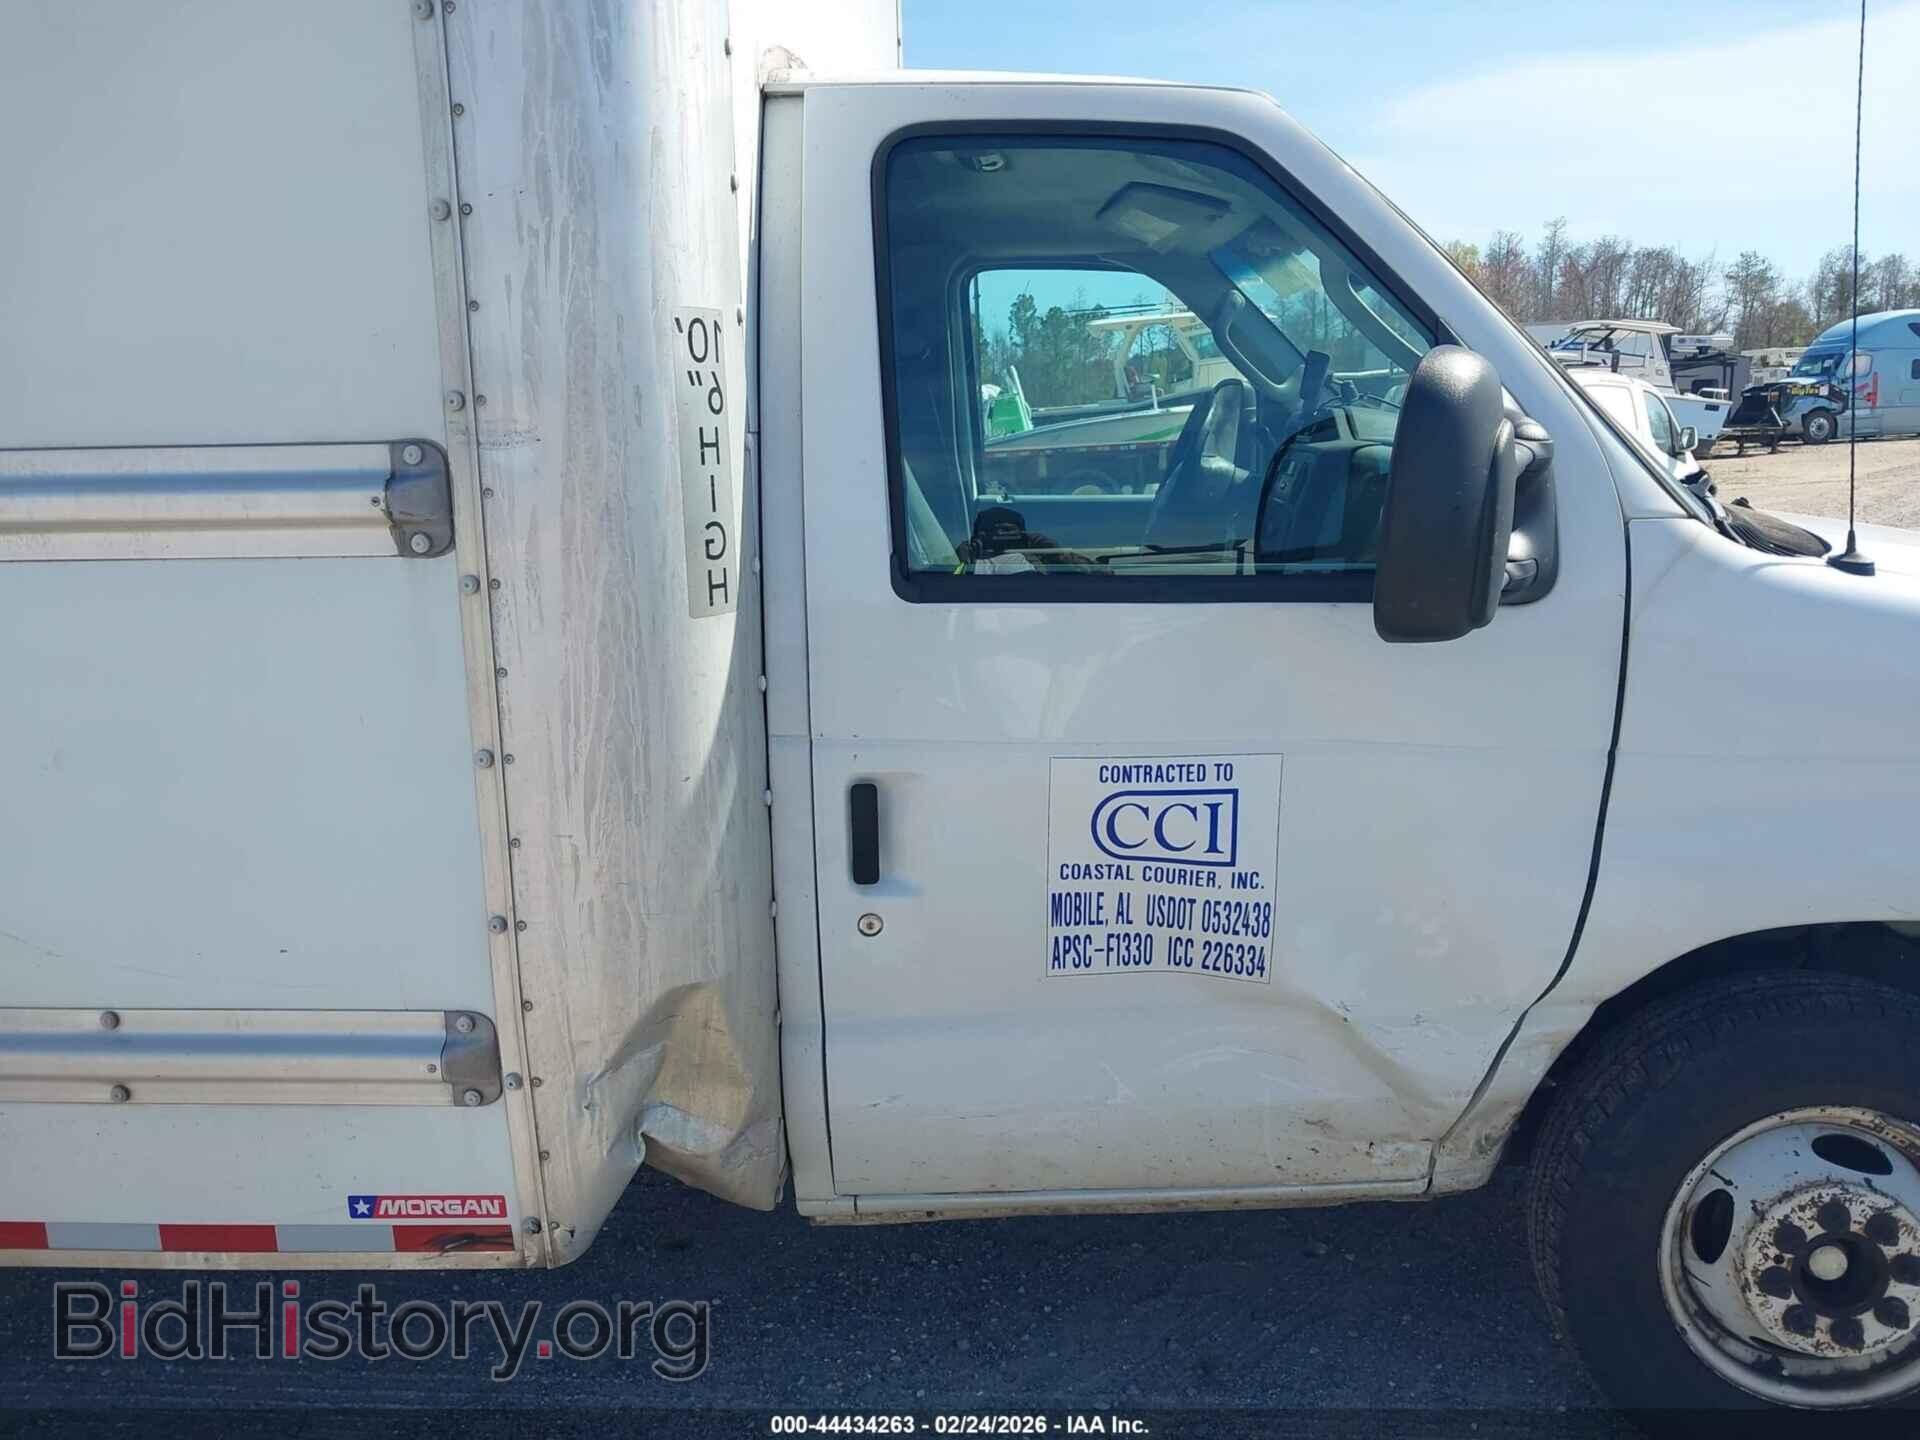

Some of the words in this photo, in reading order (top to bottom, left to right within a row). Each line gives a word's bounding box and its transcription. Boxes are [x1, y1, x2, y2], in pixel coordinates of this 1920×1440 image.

[1099, 764, 1206, 784] CONTRACTED
[1214, 763, 1234, 781] TO
[1106, 802, 1224, 854] CCI
[1060, 863, 1134, 881] COASTAL
[1230, 871, 1265, 890] INC.
[1051, 892, 1109, 927] MOBILE,
[1115, 892, 1133, 925] AL
[1146, 894, 1197, 930] USDOT
[1201, 899, 1271, 938] 0532438
[1051, 932, 1153, 970] APSC-F1330
[1167, 936, 1194, 968] ICC
[1201, 940, 1266, 978] 226334
[379, 1199, 500, 1216] MORGAN
